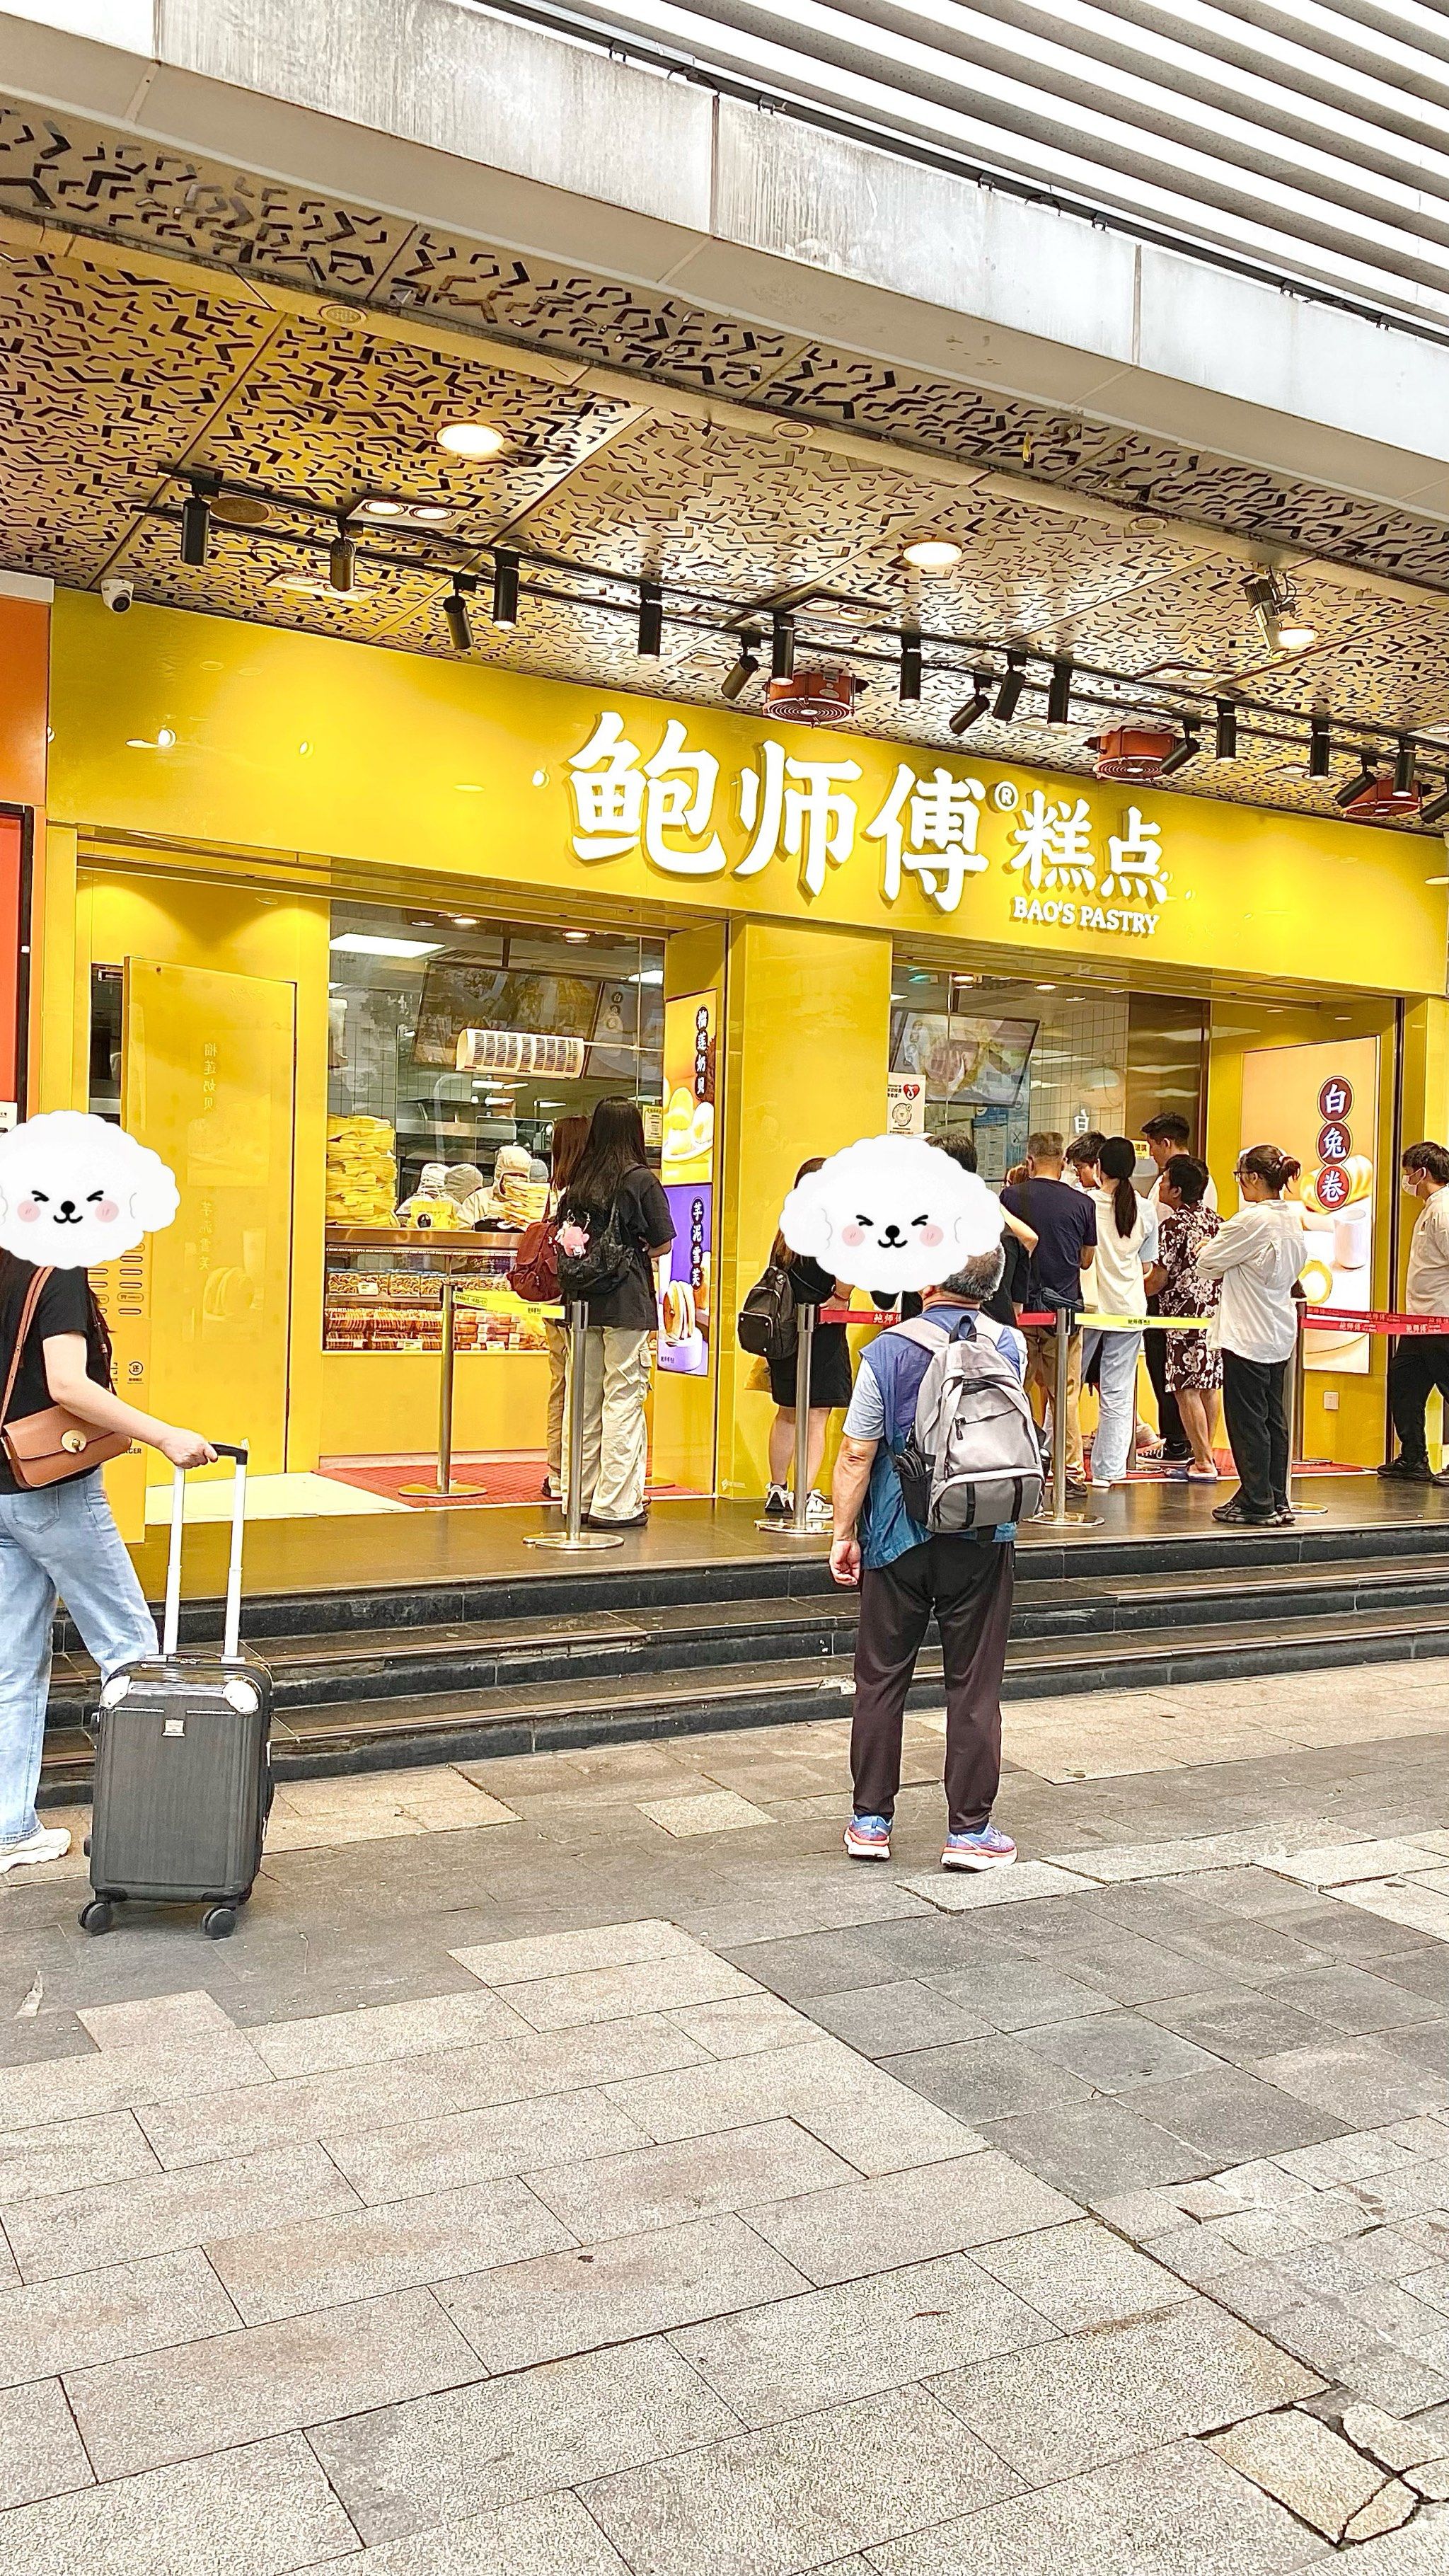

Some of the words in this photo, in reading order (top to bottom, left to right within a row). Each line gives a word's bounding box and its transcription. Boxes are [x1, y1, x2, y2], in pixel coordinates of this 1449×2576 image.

[1014, 897, 1075, 924] BAO'S
[1080, 906, 1160, 934] PASTRY
[697, 1010, 708, 1094] 榴莲奶贝
[1320, 1083, 1346, 1202] 白兔卷
[692, 1201, 703, 1286] 芋泥雪芙
